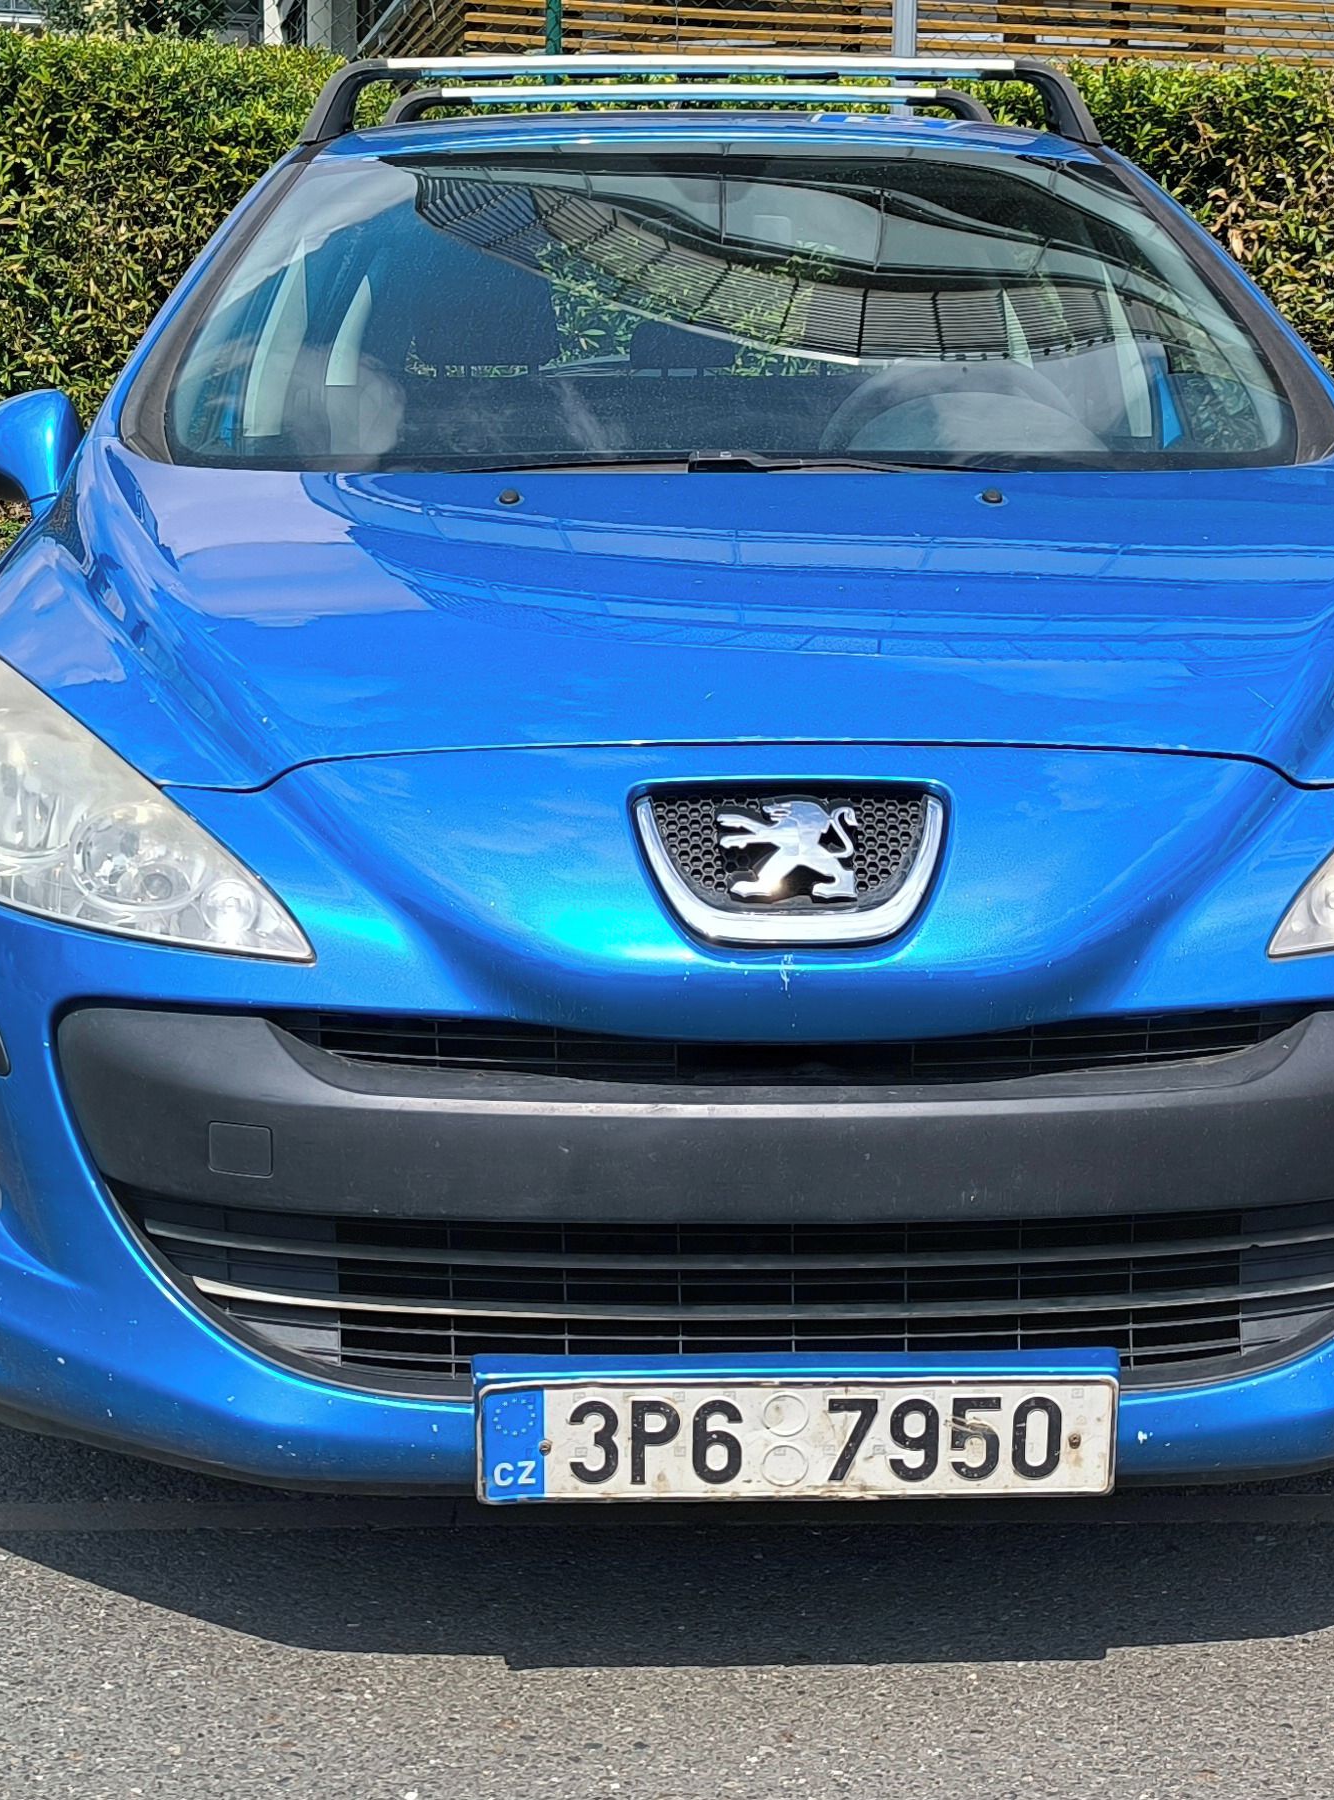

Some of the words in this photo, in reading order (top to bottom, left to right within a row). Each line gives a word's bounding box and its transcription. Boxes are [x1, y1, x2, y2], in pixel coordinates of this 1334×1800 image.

[568, 1398, 742, 1485] 3P6
[828, 1397, 1062, 1482] 7950
[494, 1462, 536, 1486] CZ
